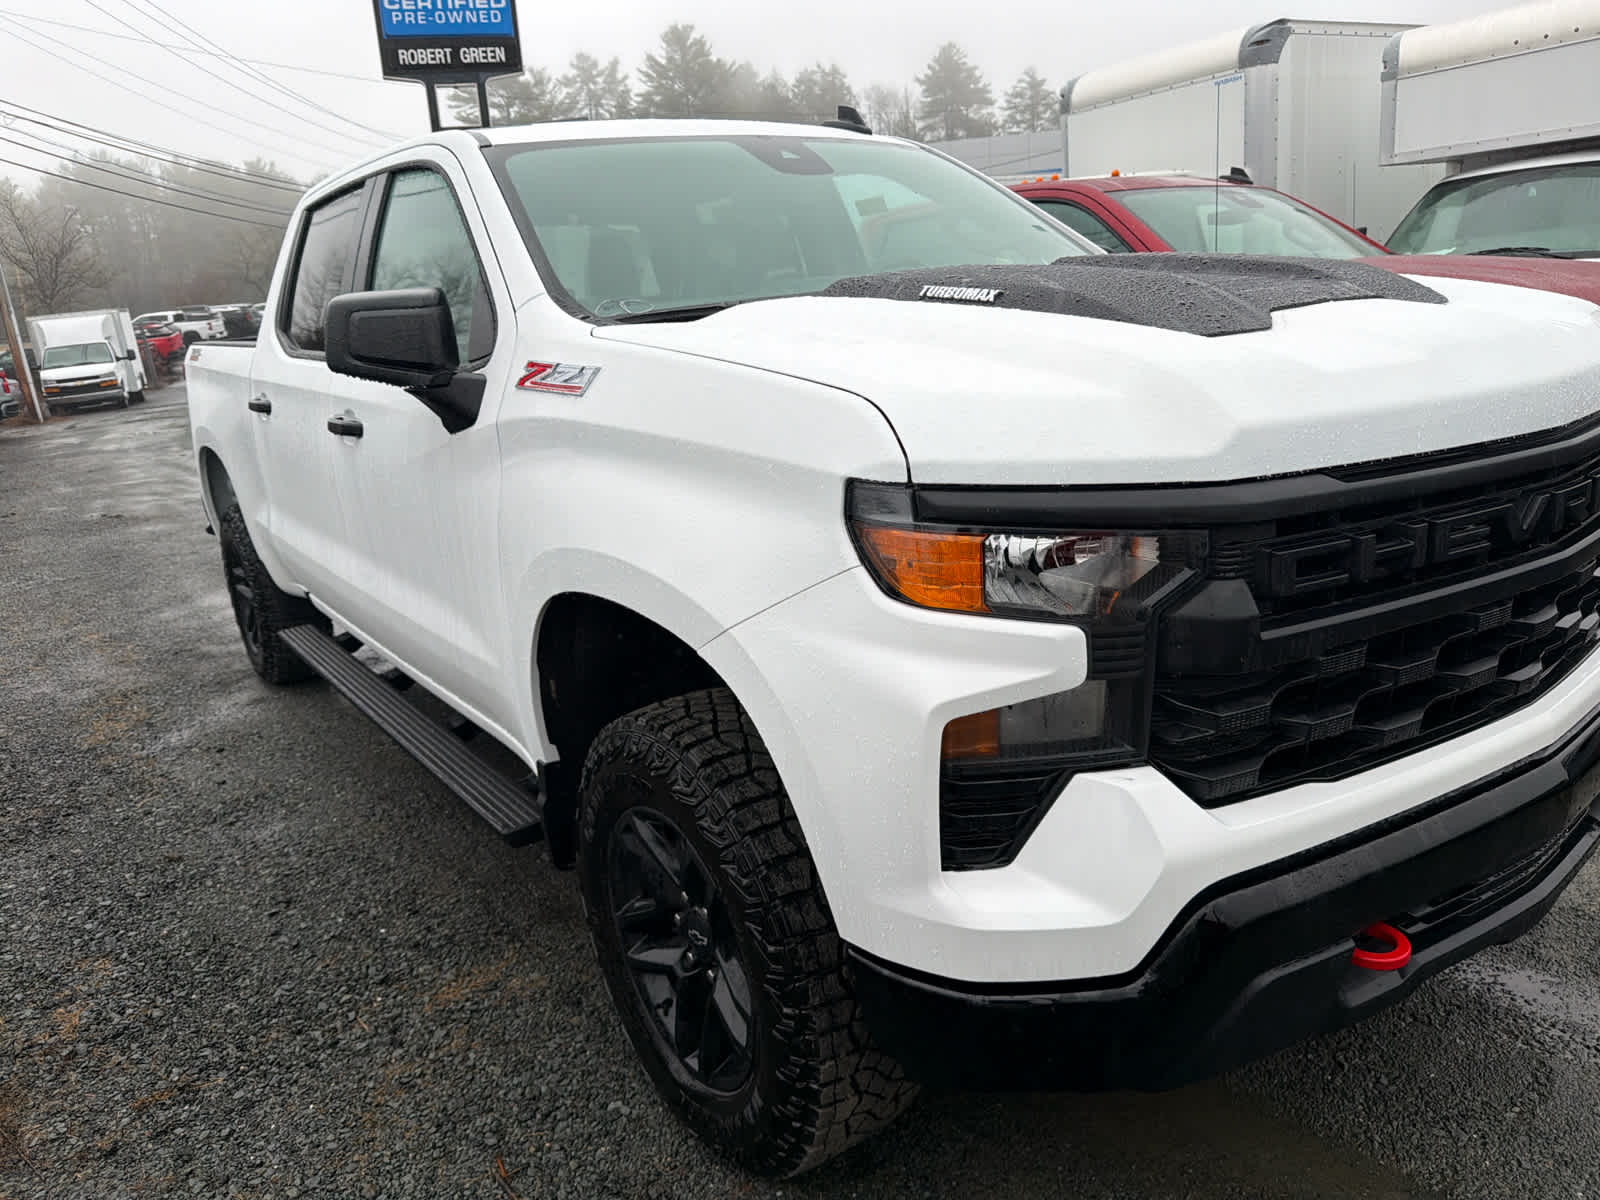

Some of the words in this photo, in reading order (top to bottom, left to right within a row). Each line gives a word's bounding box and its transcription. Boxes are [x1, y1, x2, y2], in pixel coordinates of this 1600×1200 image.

[392, 11, 502, 24] PRE-OWNED
[398, 49, 453, 65] ROBERT
[460, 47, 506, 63] GREEN
[919, 285, 1000, 302] TURBOMAX
[515, 360, 601, 397] Z71
[1258, 474, 1600, 598] CHEVR
